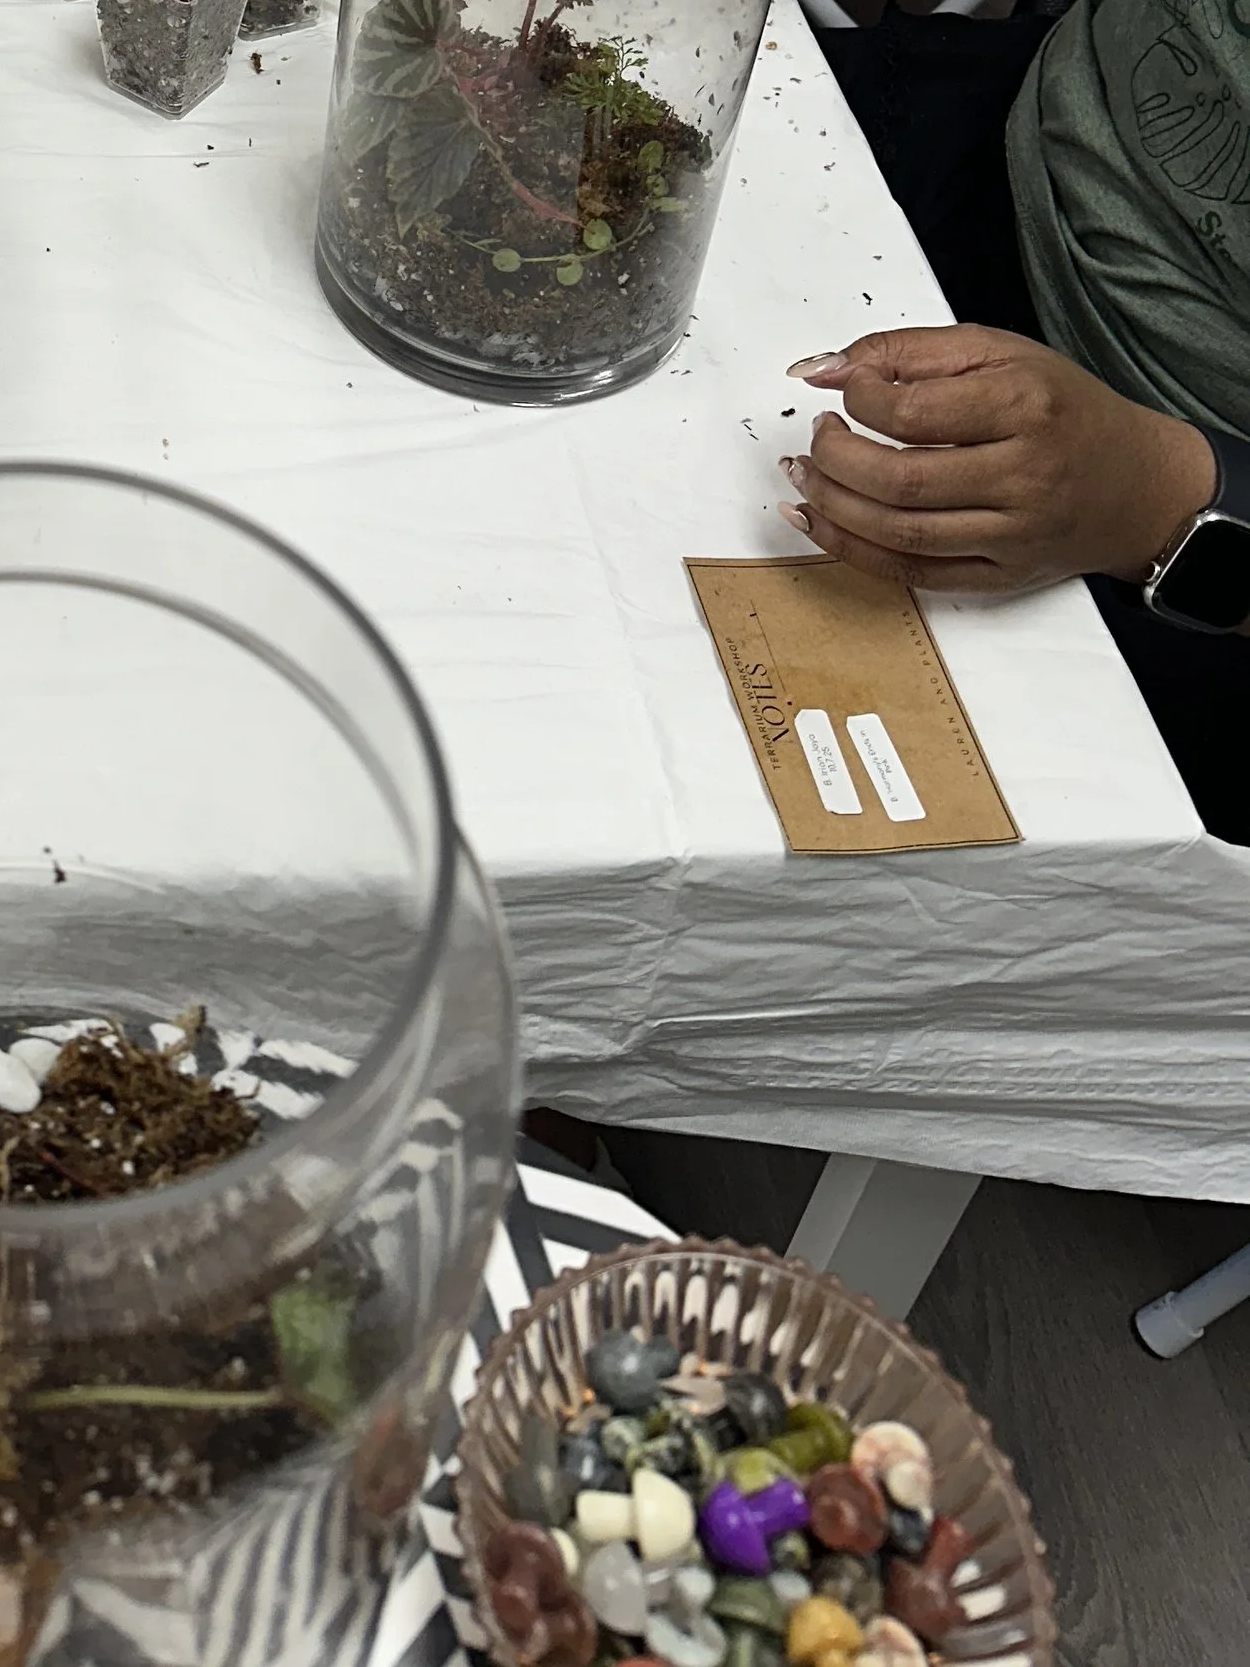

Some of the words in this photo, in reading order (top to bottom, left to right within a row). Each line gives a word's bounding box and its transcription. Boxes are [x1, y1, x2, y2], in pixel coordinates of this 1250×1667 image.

[901, 611, 930, 666] PLANTS
[726, 638, 754, 703] WORKSHOP
[930, 677, 948, 706] AND
[750, 664, 789, 742] NOTES
[753, 704, 782, 770] TERRARIUM
[947, 718, 978, 776] LAUREN
